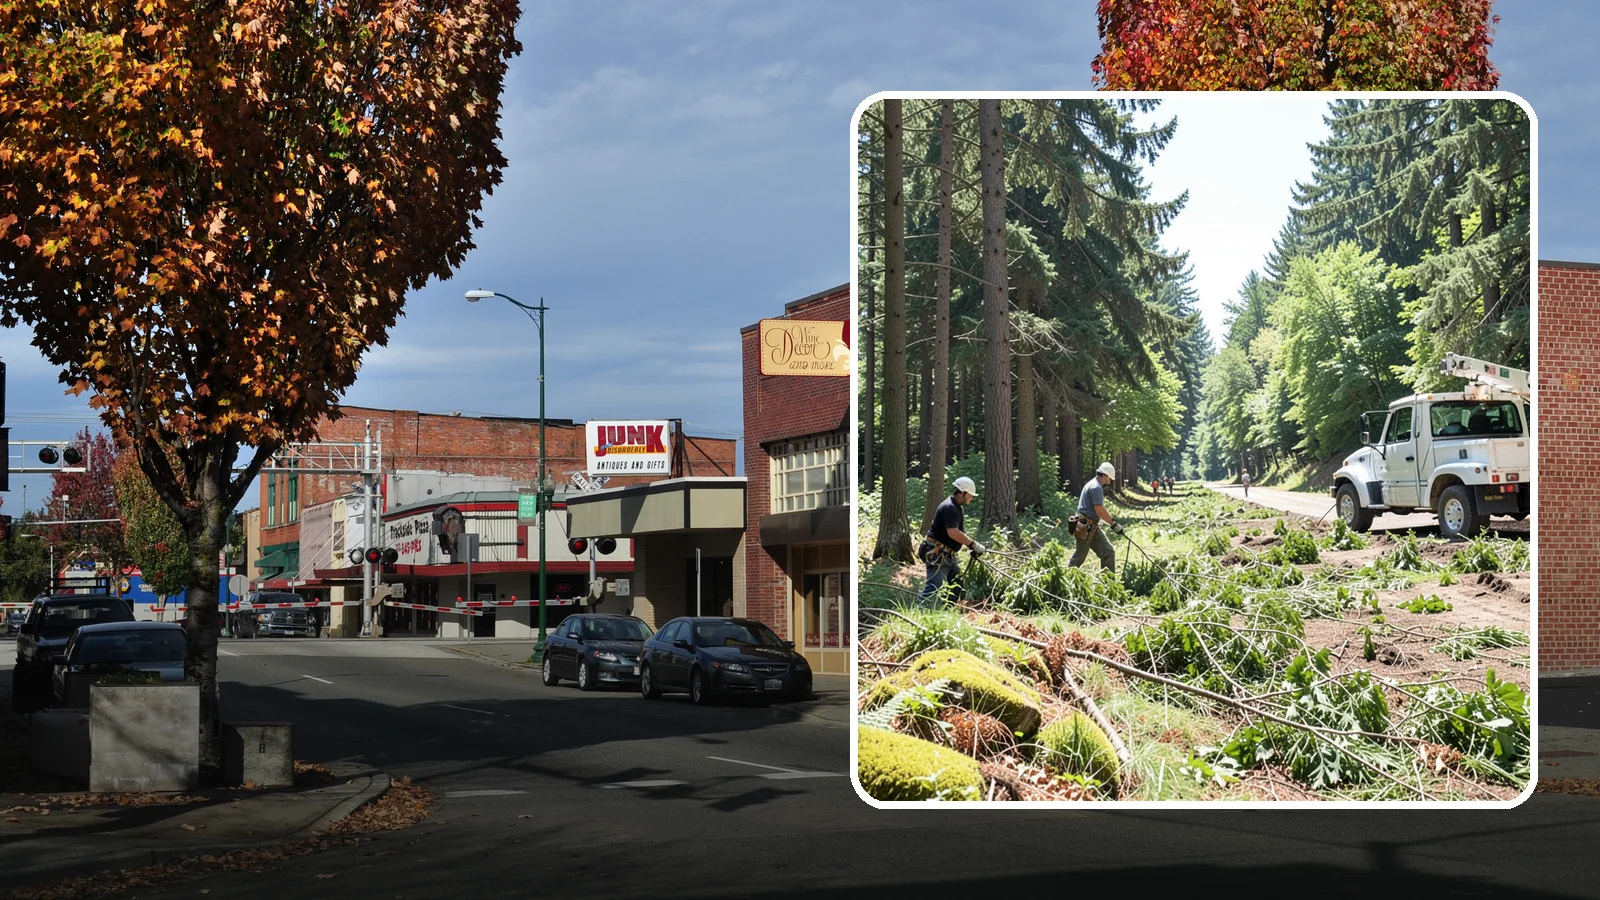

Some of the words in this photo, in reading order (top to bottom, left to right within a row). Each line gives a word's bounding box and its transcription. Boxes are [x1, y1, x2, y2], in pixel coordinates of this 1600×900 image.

[595, 425, 666, 457] JUNK
[607, 446, 645, 454] DISORDERLY
[597, 461, 628, 470] ANTIQUES
[631, 461, 644, 470] AND
[647, 461, 665, 469] GIFTS
[414, 519, 429, 535] Pizza
